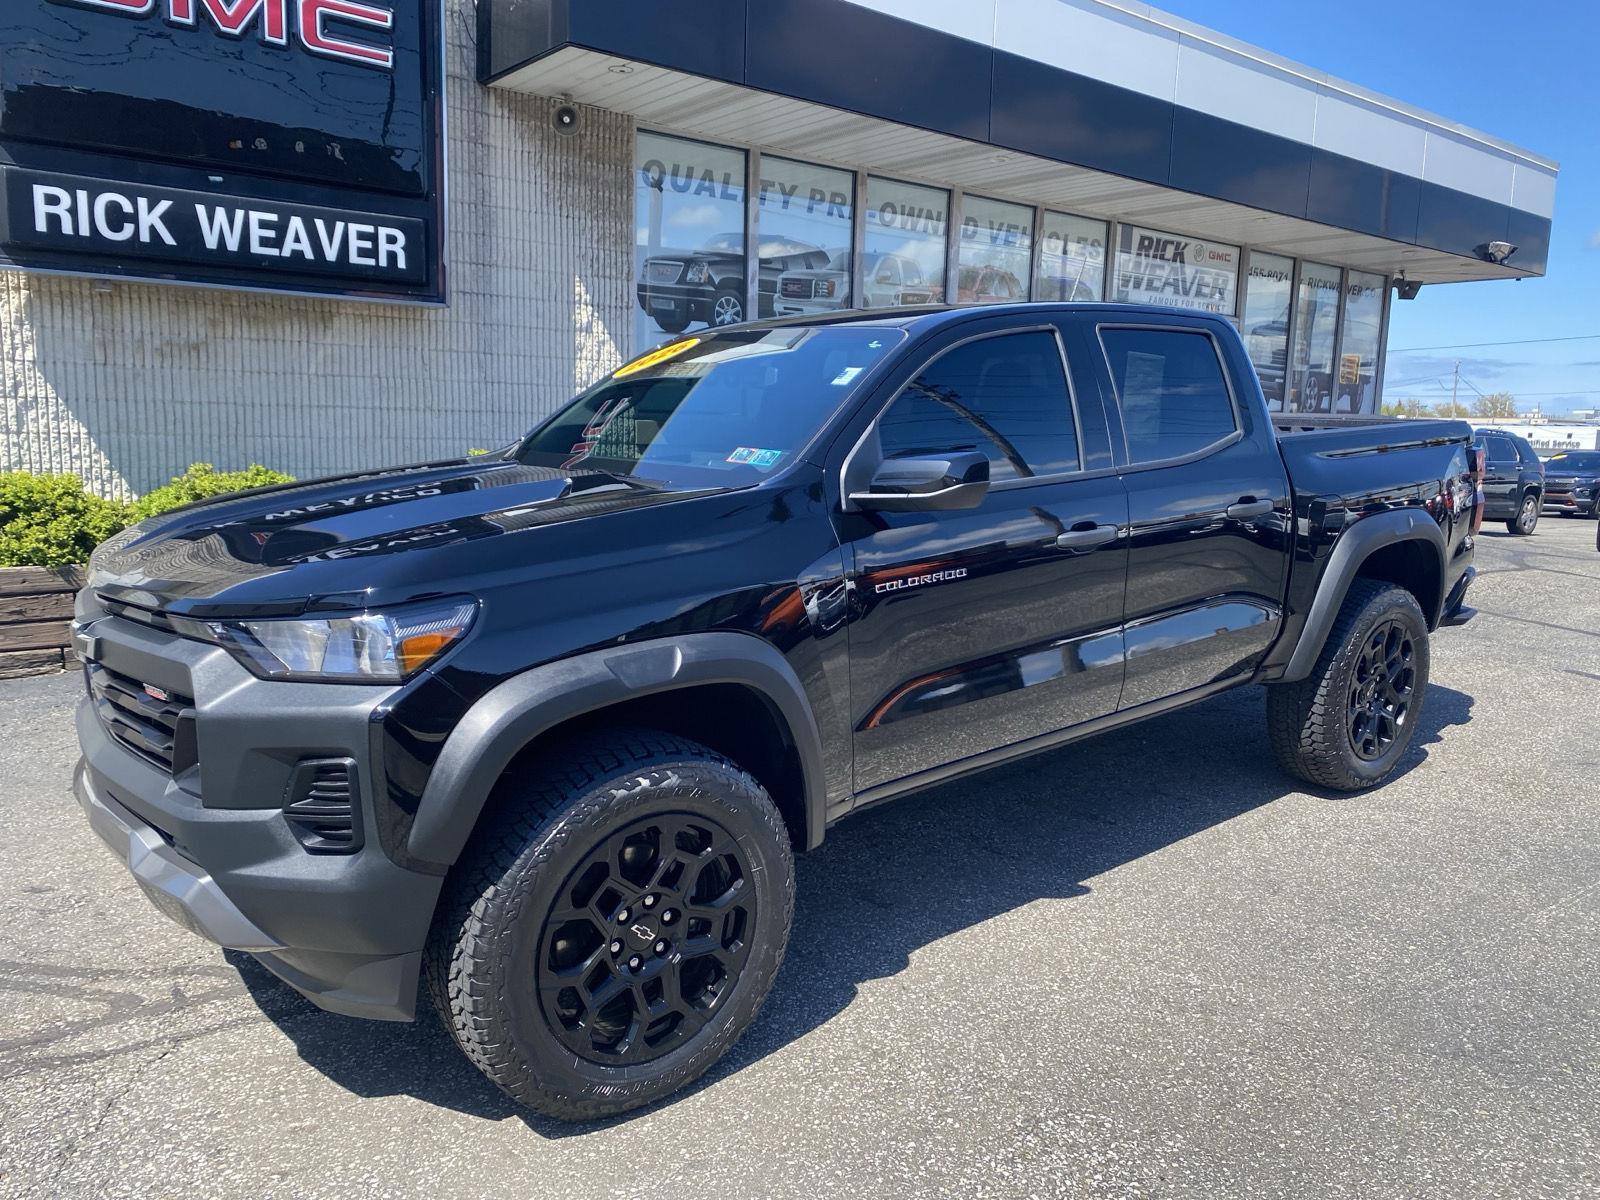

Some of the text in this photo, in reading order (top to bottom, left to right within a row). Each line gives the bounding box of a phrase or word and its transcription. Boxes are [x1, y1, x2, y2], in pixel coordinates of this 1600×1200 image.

[46, 0, 394, 69] MC
[641, 159, 798, 210] QUALTY
[32, 183, 407, 270] RICK WEAVER
[1136, 235, 1192, 264] RICK
[1208, 250, 1232, 263] GMC
[1120, 259, 1230, 300] WEAVER
[1148, 295, 1179, 307] FAMOUS
[1552, 440, 1581, 449] Service
[875, 567, 968, 594] COLORADO
